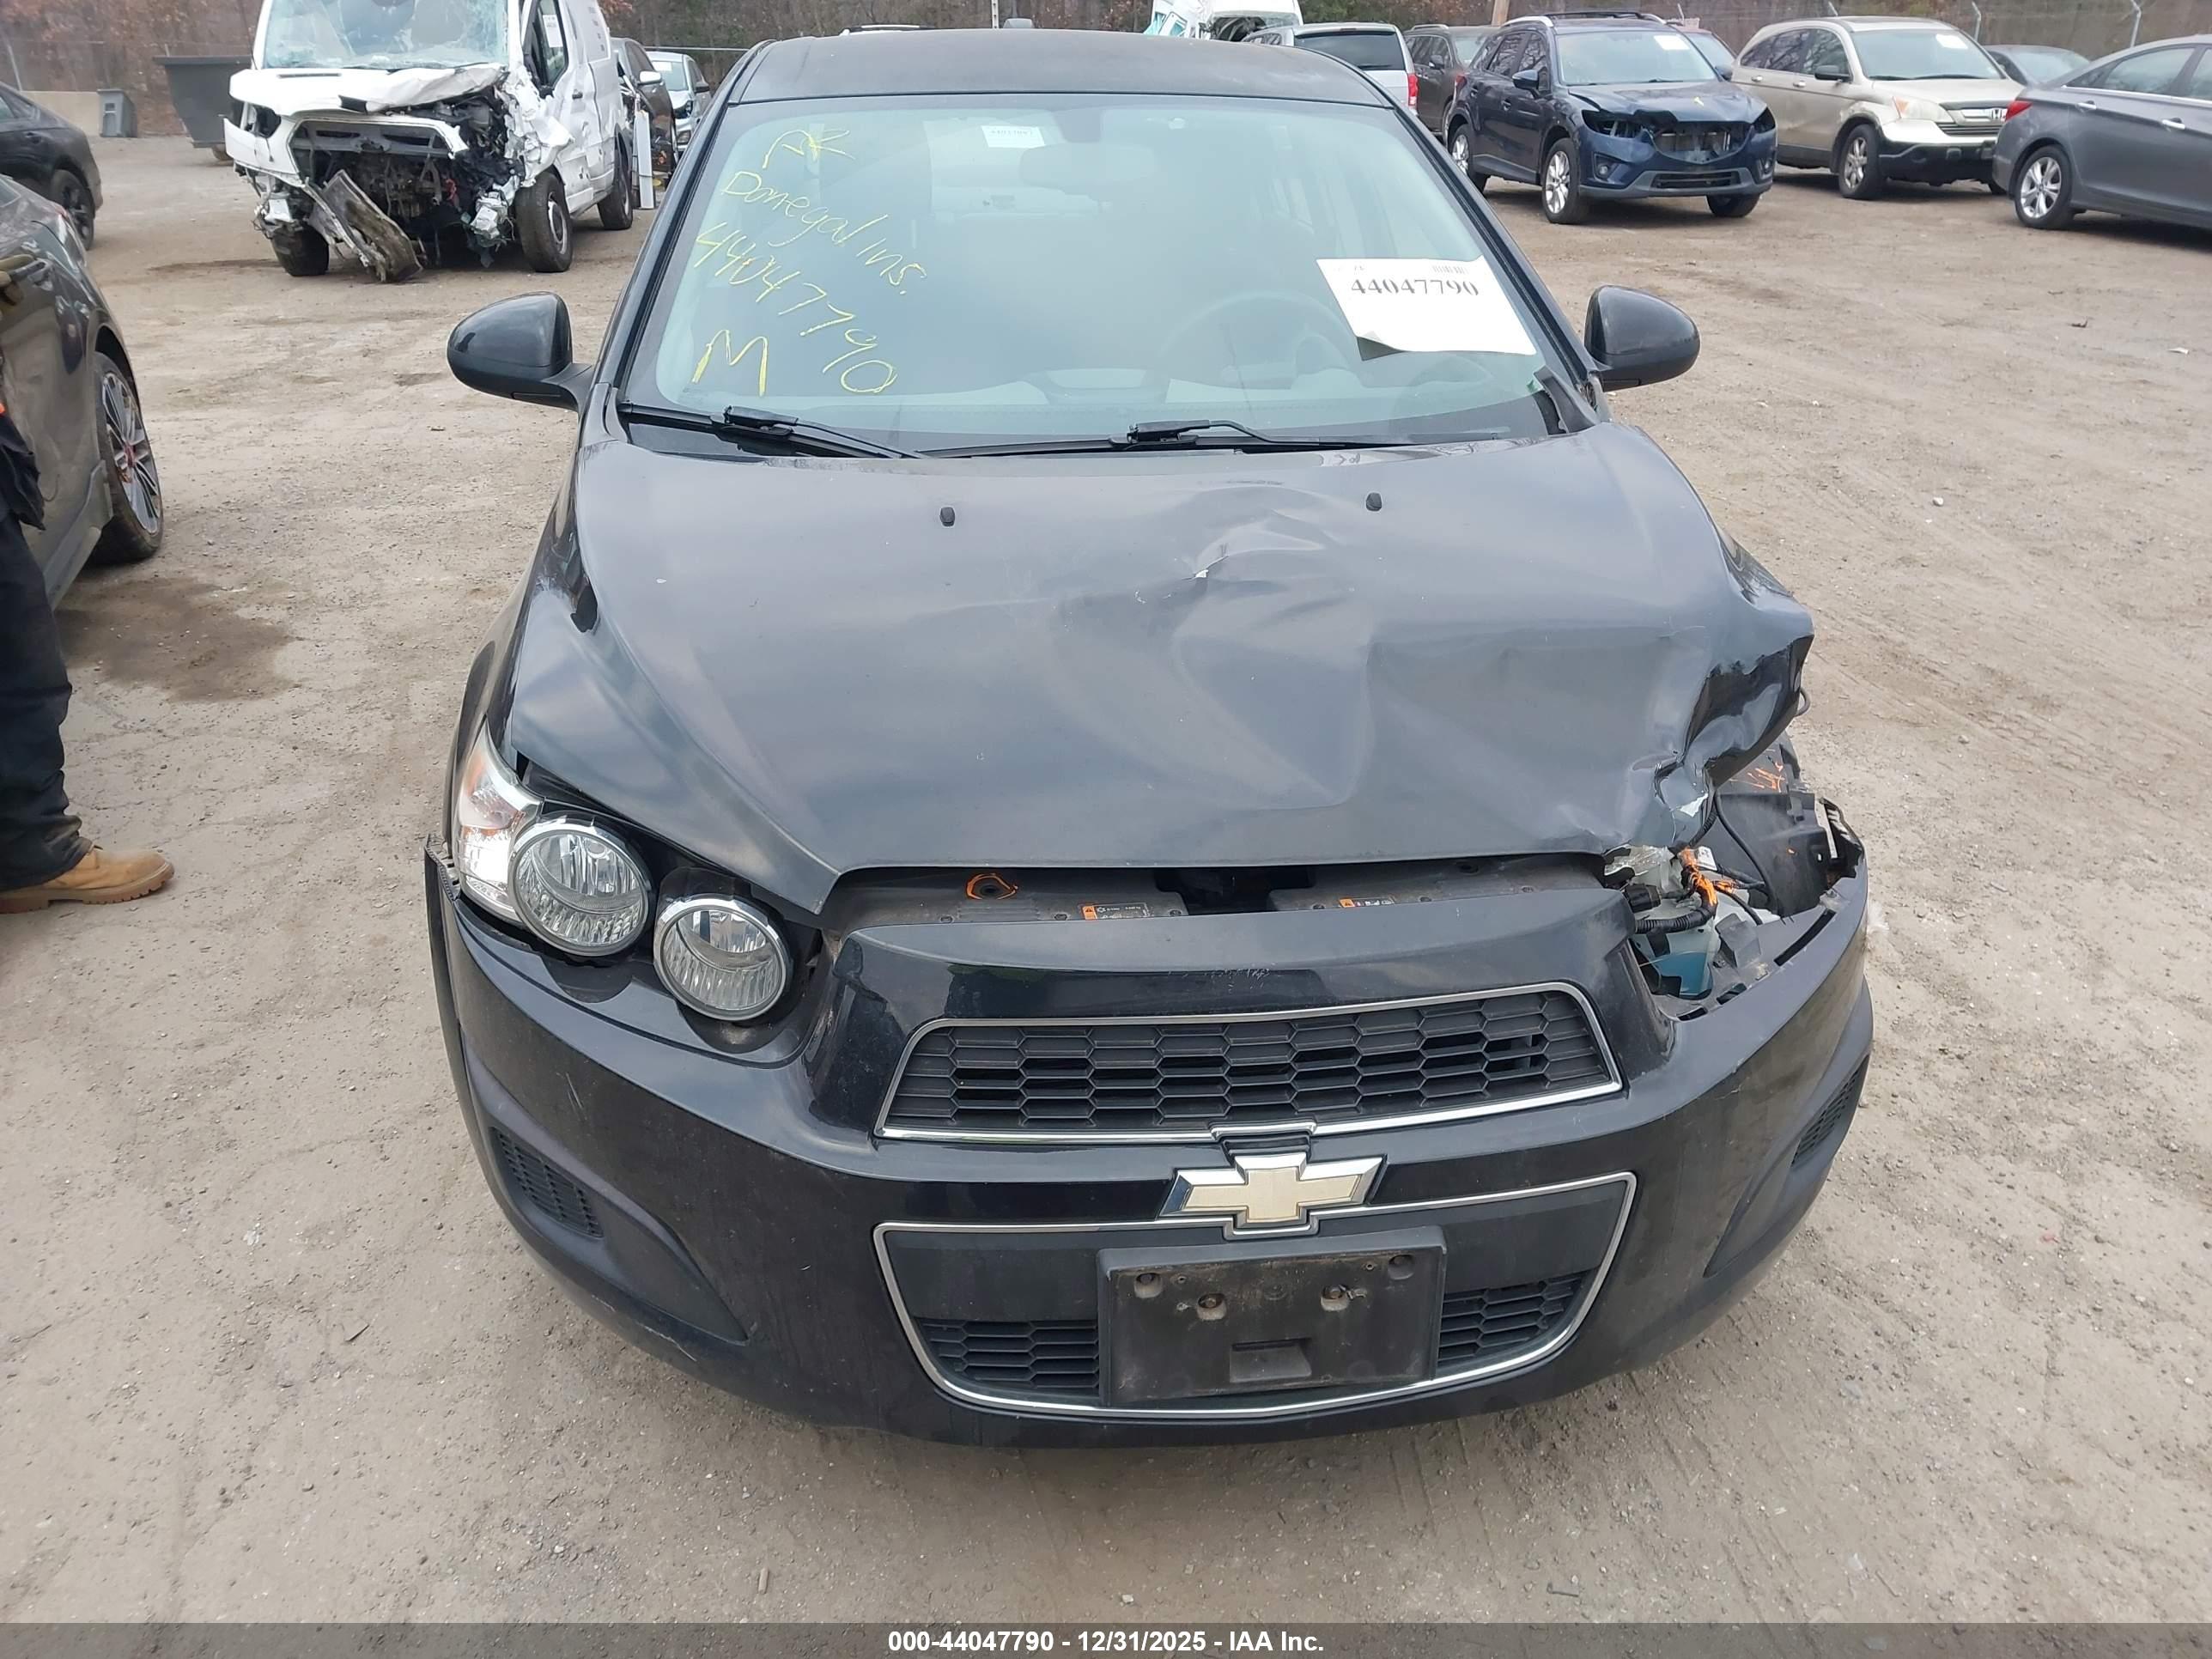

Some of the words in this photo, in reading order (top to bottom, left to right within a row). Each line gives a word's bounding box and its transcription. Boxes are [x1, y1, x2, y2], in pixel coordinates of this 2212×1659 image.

[721, 170, 888, 246] Donegal
[694, 222, 898, 393] 44047790
[1351, 277, 1480, 296] 44047790
[692, 329, 768, 397] M
